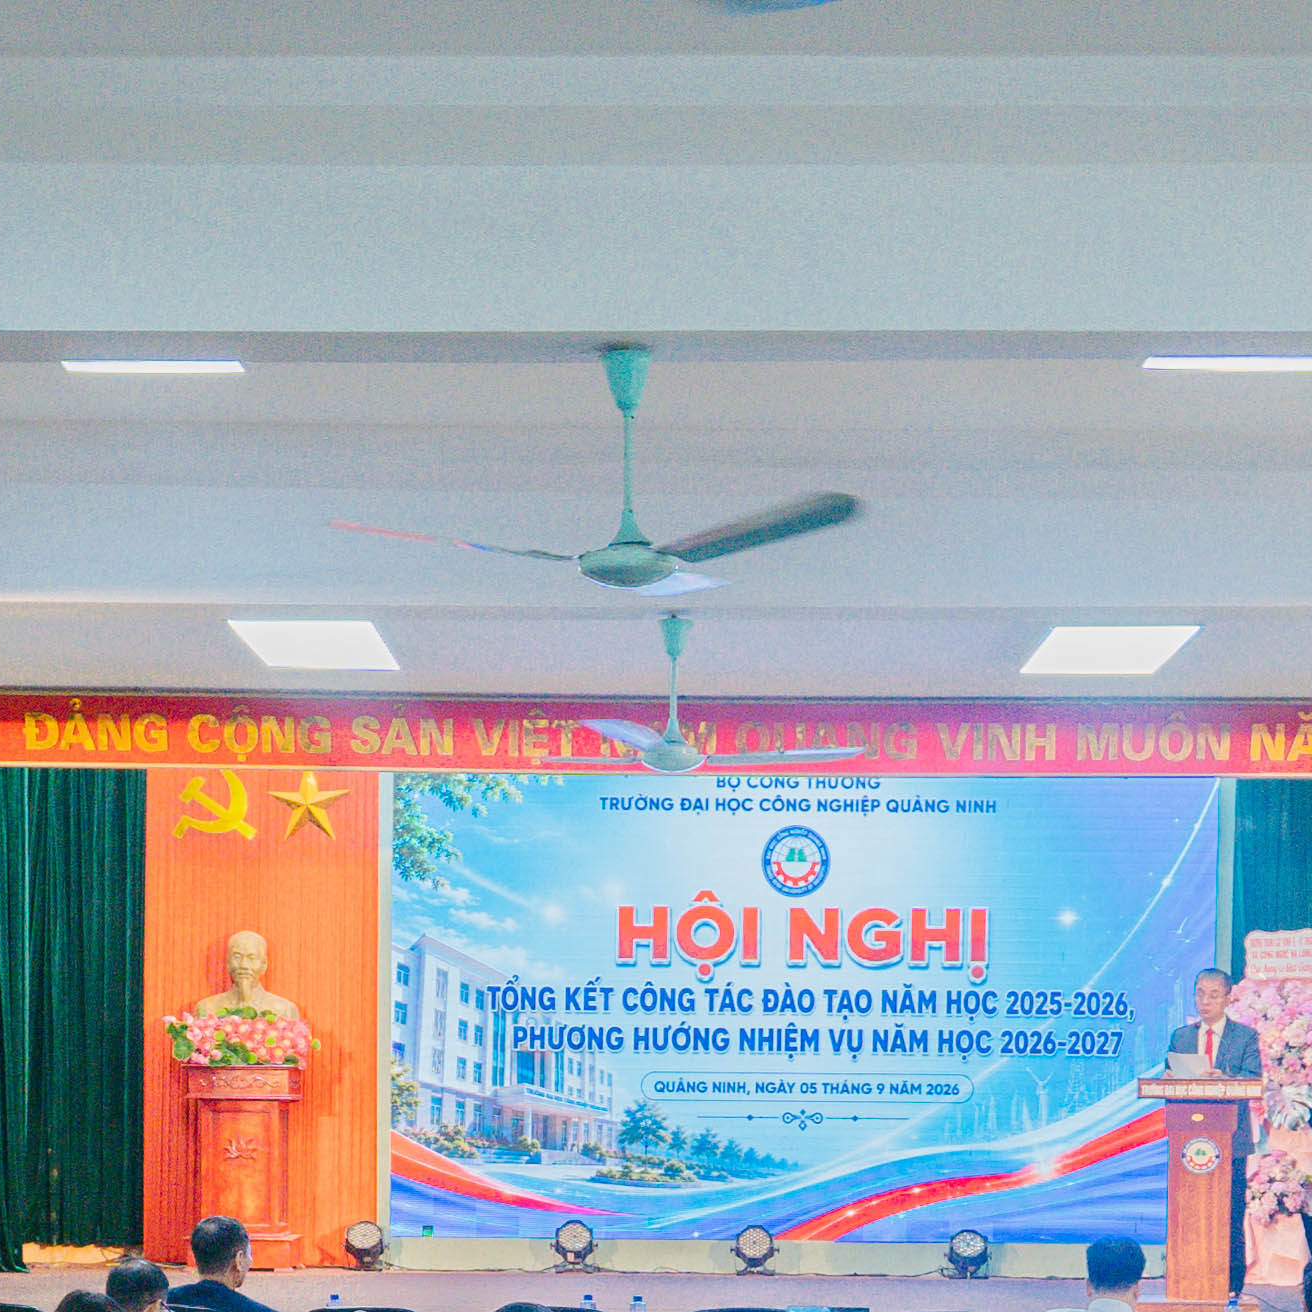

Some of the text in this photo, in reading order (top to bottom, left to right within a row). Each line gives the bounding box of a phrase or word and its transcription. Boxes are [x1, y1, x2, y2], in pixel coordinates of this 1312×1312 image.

[24, 699, 167, 754] ĐẢNG
[188, 706, 332, 762] CỘNG
[350, 702, 454, 757] SẢN
[939, 722, 1056, 762] VINH
[1077, 711, 1231, 762] MUÔN
[600, 794, 997, 816] TRƯỜNG ĐẠI HỌC CÔNG NGHIỆP QUẢNG NINH
[619, 891, 986, 976] HỘI NGHỊ
[487, 975, 1133, 1021] TỔNG KẾT CÔNG TÁC ĐÀO TẠO NĂM HỌC 2025-2026,
[514, 1022, 1122, 1060] PHƯƠNG HƯỚNG NHIỆM VỤ NĂM HỌC 2026-2027
[654, 1077, 960, 1097] QUẢNG NINH, NGÀY 05 THÁNG 9 NĂM 2026
